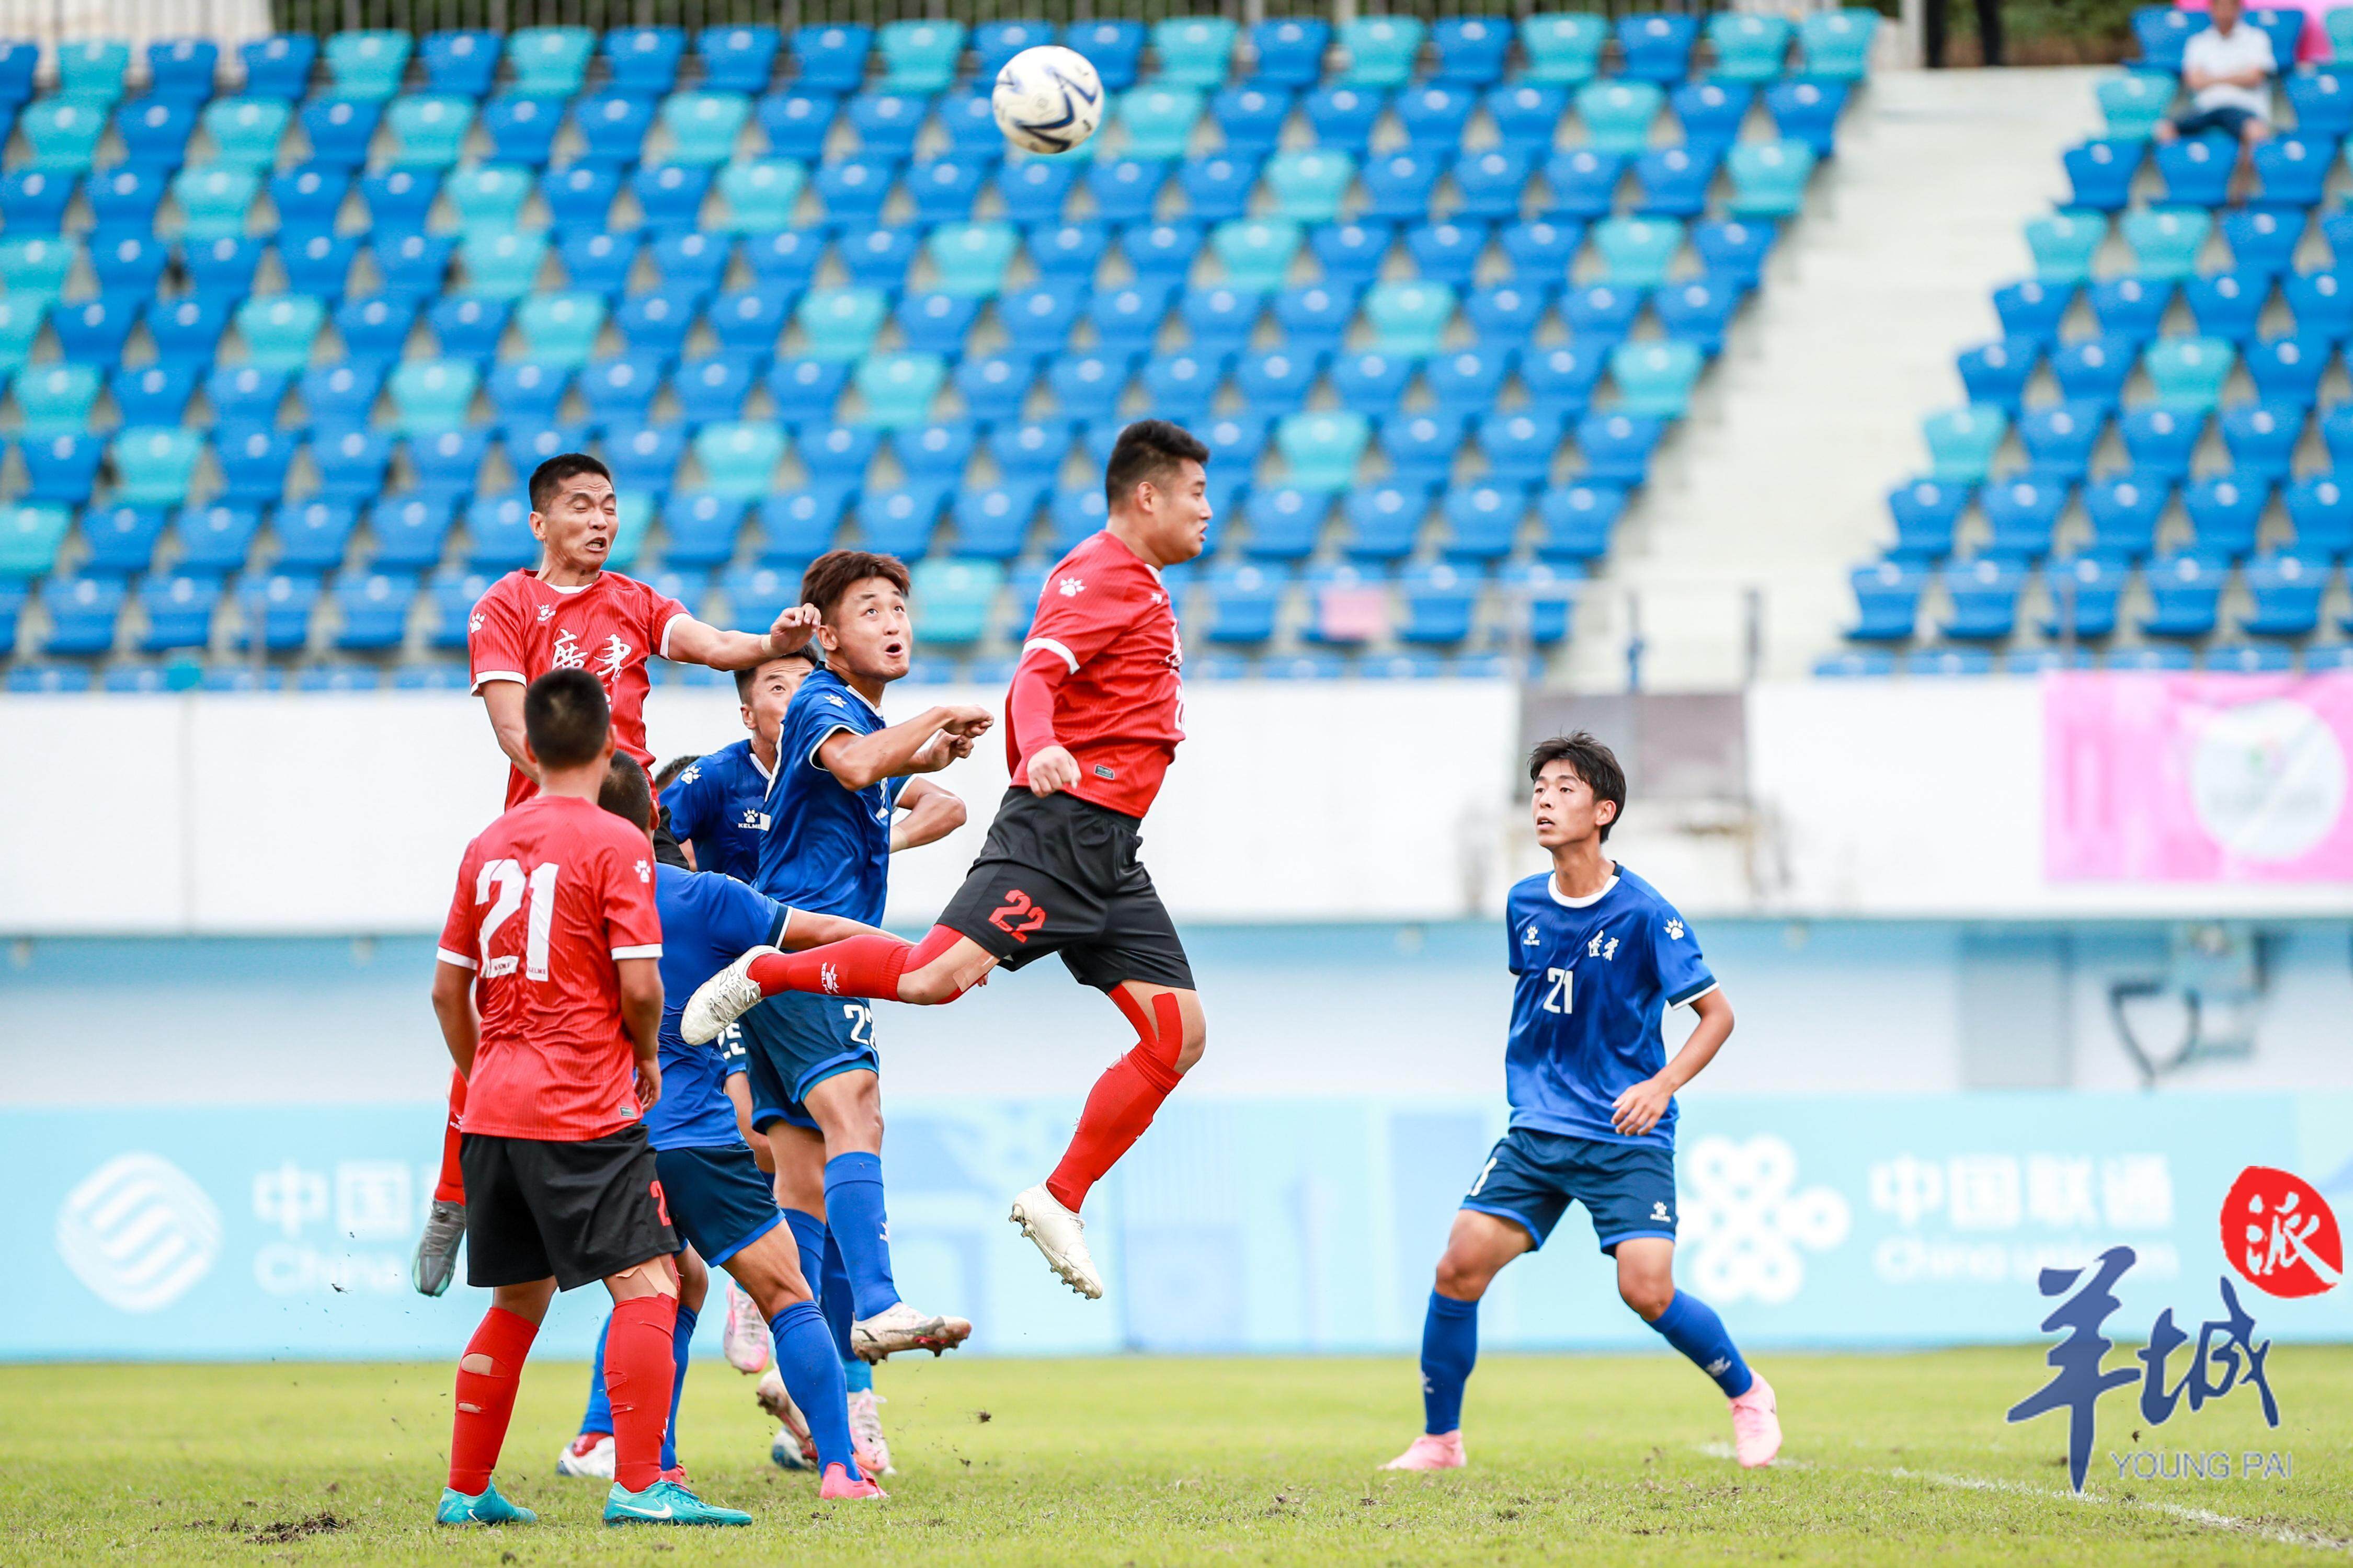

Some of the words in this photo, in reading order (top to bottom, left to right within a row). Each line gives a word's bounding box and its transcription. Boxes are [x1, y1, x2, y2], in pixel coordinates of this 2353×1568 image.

[475, 859, 559, 982] 21
[988, 889, 1046, 944] 22
[1543, 967, 1573, 1014] 21
[251, 1157, 438, 1240] 中国
